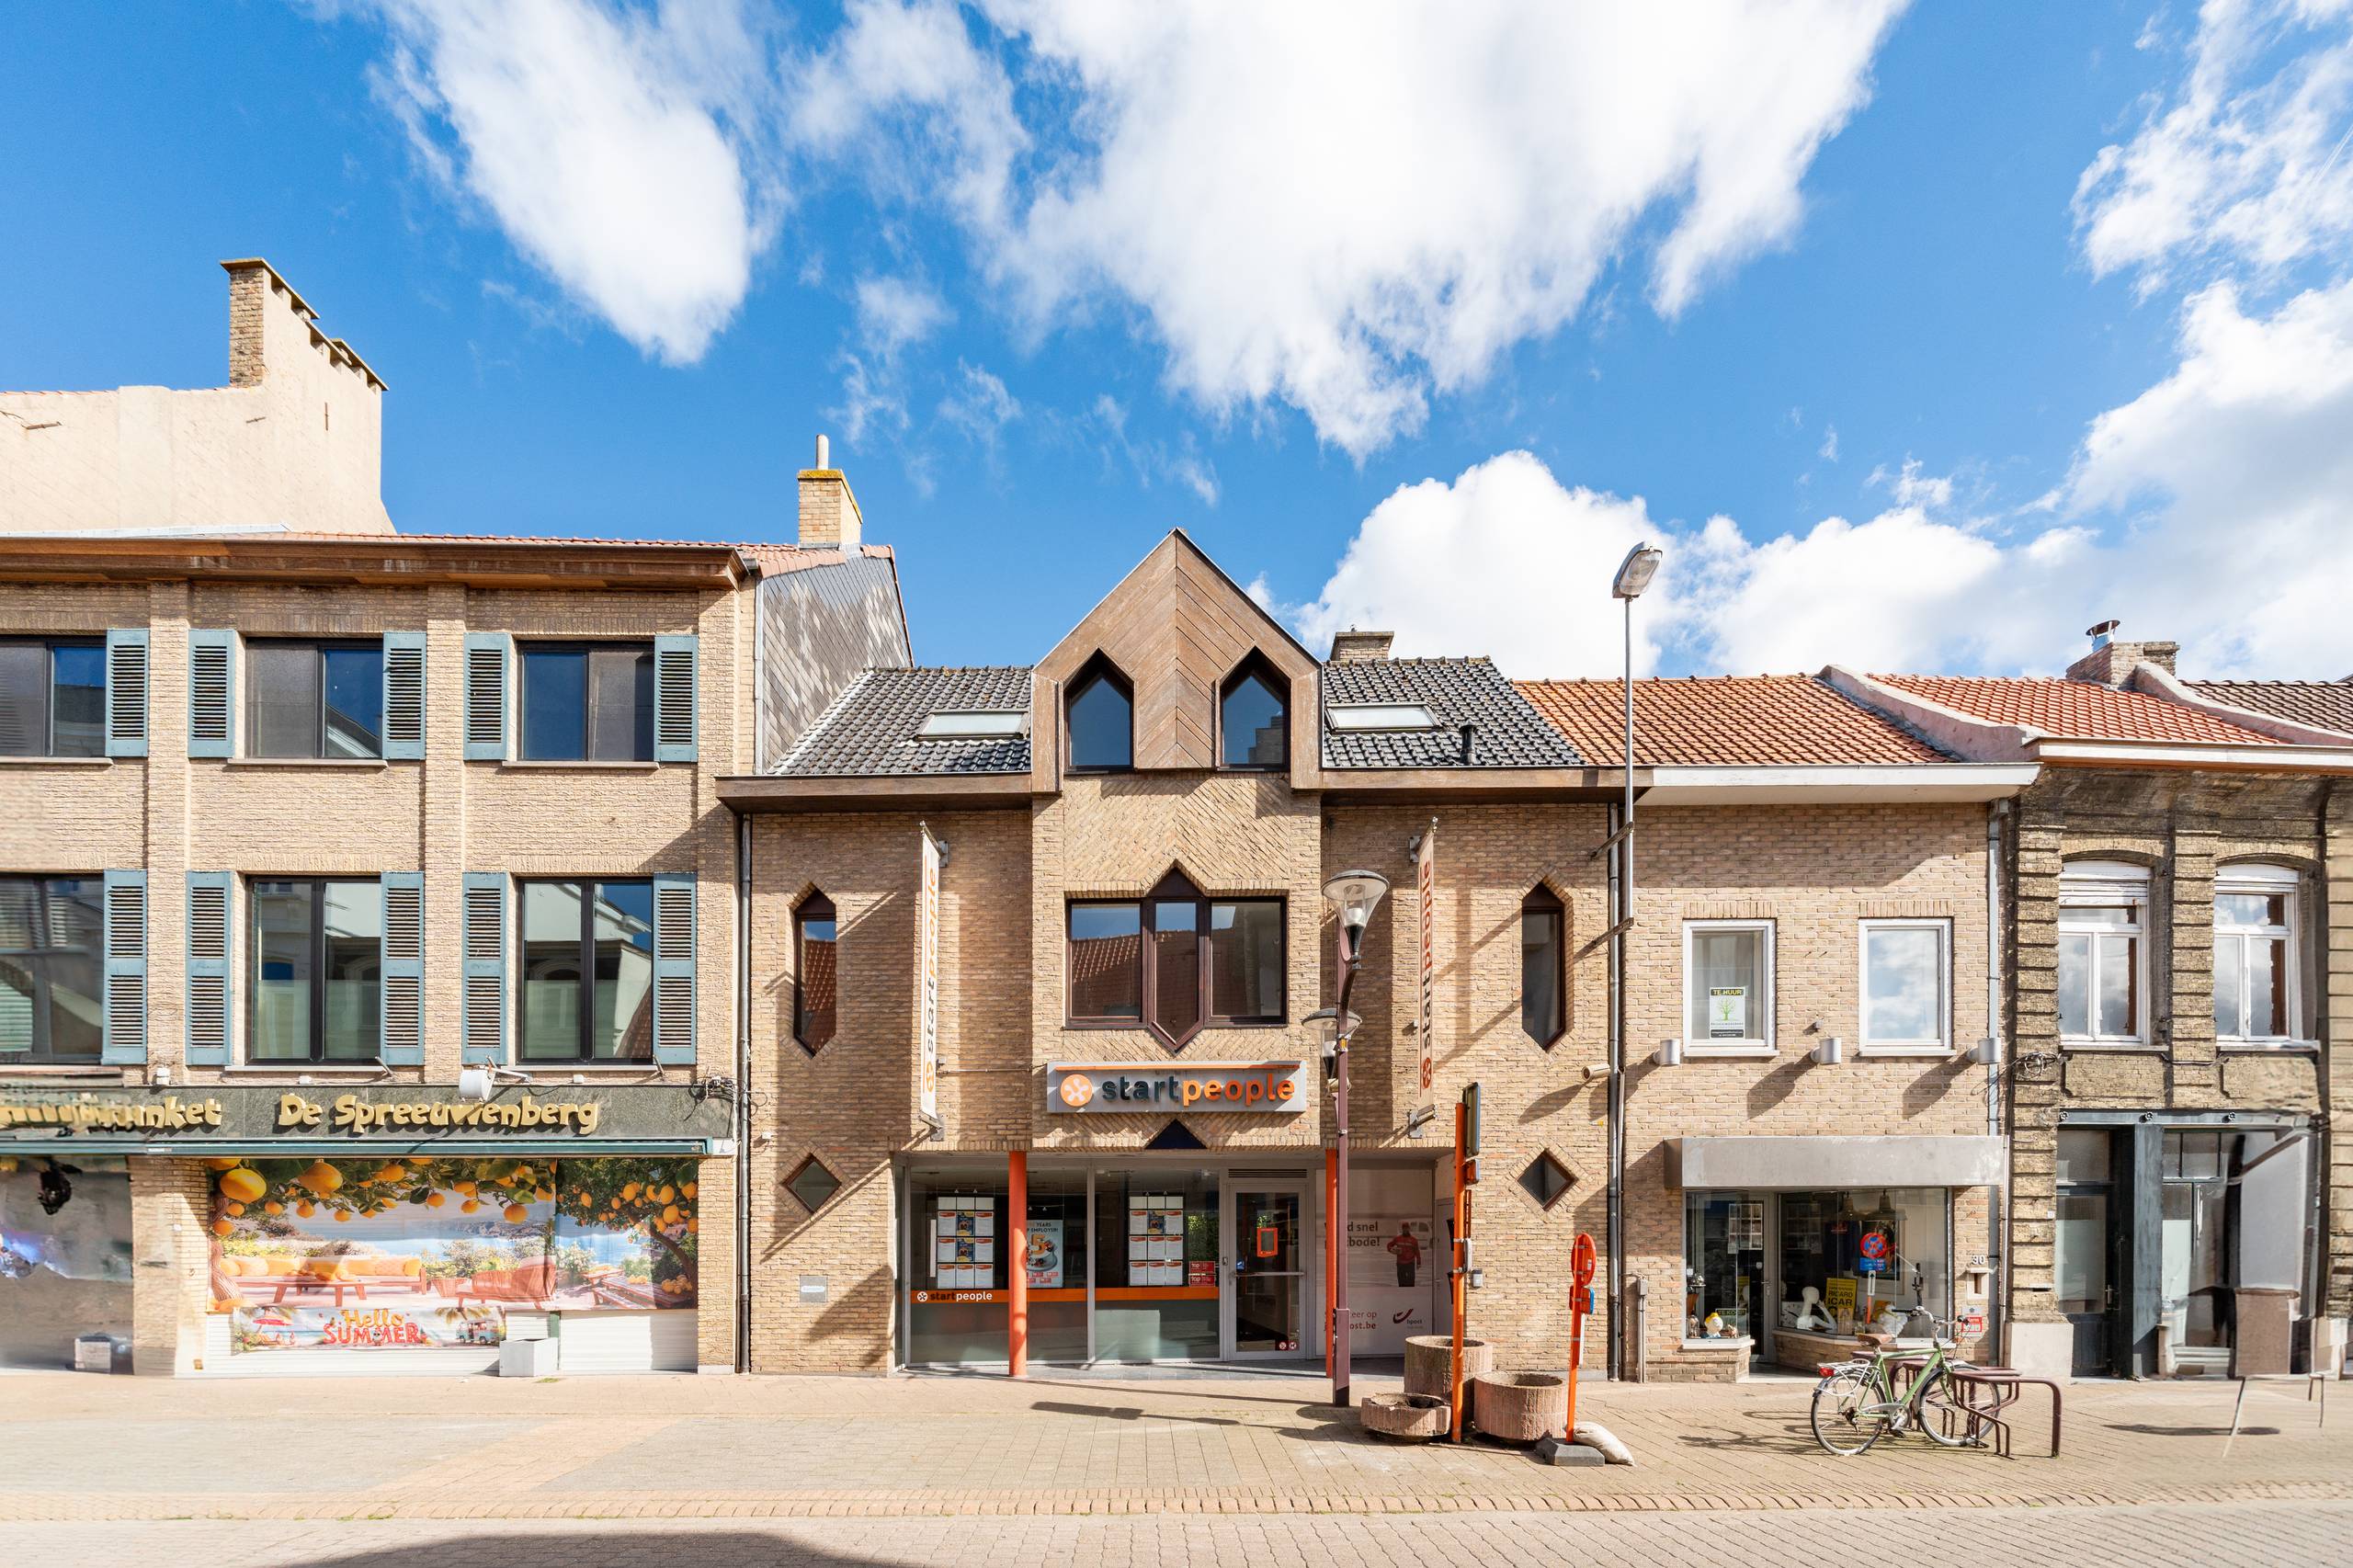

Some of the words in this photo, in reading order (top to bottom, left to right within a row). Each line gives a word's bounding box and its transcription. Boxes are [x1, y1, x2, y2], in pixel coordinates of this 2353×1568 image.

[926, 867, 938, 1053] startpeople
[1422, 860, 1432, 1051] startpeople
[1102, 1073, 1296, 1107] startpeople
[278, 1093, 323, 1127] De
[335, 1094, 599, 1135] Spreeuwenberg
[1356, 1221, 1379, 1233] snel
[1972, 1255, 1985, 1265] 30
[930, 1290, 994, 1302] startpeople
[341, 1309, 404, 1328] Hello
[1367, 1312, 1377, 1320] op
[323, 1322, 421, 1345] SUMMER
